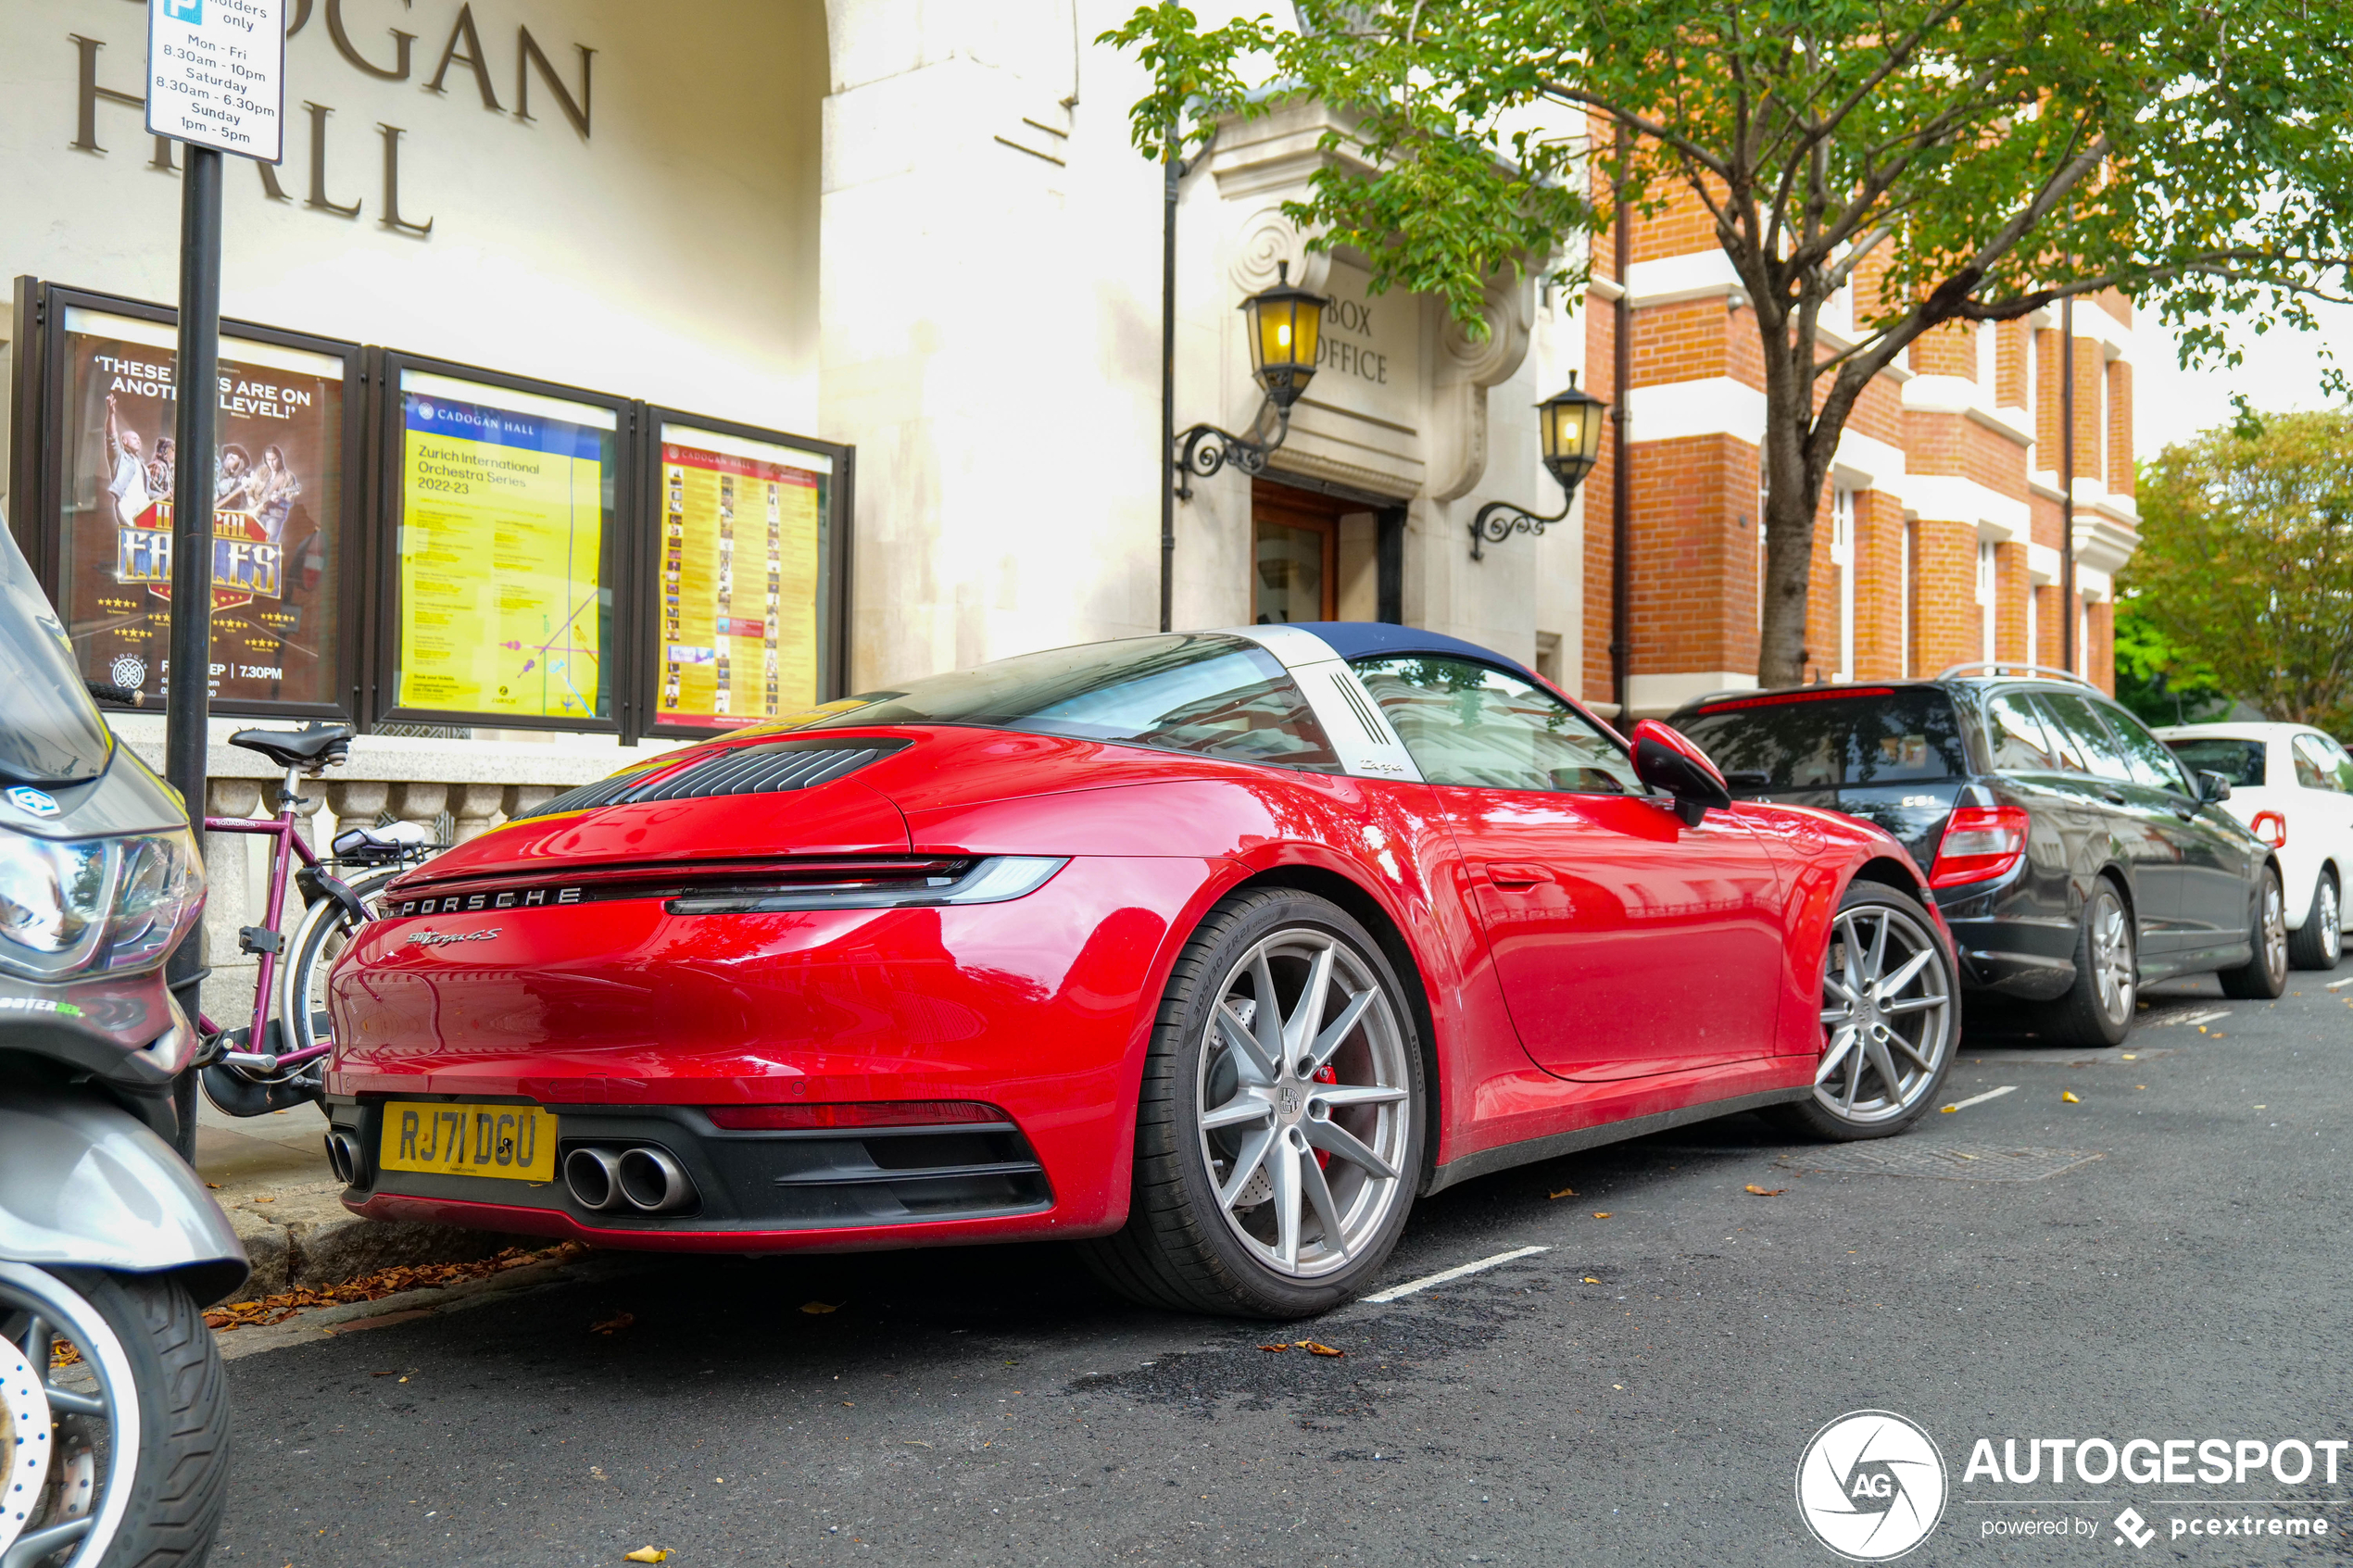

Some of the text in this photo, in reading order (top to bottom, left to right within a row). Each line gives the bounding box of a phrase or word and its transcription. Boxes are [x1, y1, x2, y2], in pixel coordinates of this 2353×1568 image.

[223, 14, 254, 31] only
[187, 34, 216, 51] Mon
[230, 46, 246, 60] Fri
[164, 44, 217, 69] 8.30am
[231, 63, 266, 82] 10pm
[185, 68, 247, 94] Saturday
[156, 76, 209, 99] 8.30am
[223, 94, 275, 117] 6.30pm
[191, 102, 241, 126] Sunday
[69, 32, 434, 235] HLL
[181, 117, 207, 132] 1pm
[220, 127, 250, 143] 5pm
[1327, 294, 1372, 337] BOX
[236, 380, 278, 400] ARE
[282, 388, 311, 407] ON
[437, 409, 535, 435] CADOGAN HALL
[419, 445, 540, 475] Zurich International
[682, 450, 751, 470] CADOGAN HALL
[418, 477, 470, 495] 2022-23
[419, 461, 526, 487] Orchestra Series
[109, 652, 148, 670] CADOGAN
[209, 663, 283, 680] EP 7.30PM
[1360, 759, 1404, 774] Targa
[401, 887, 583, 916] PORSCHE
